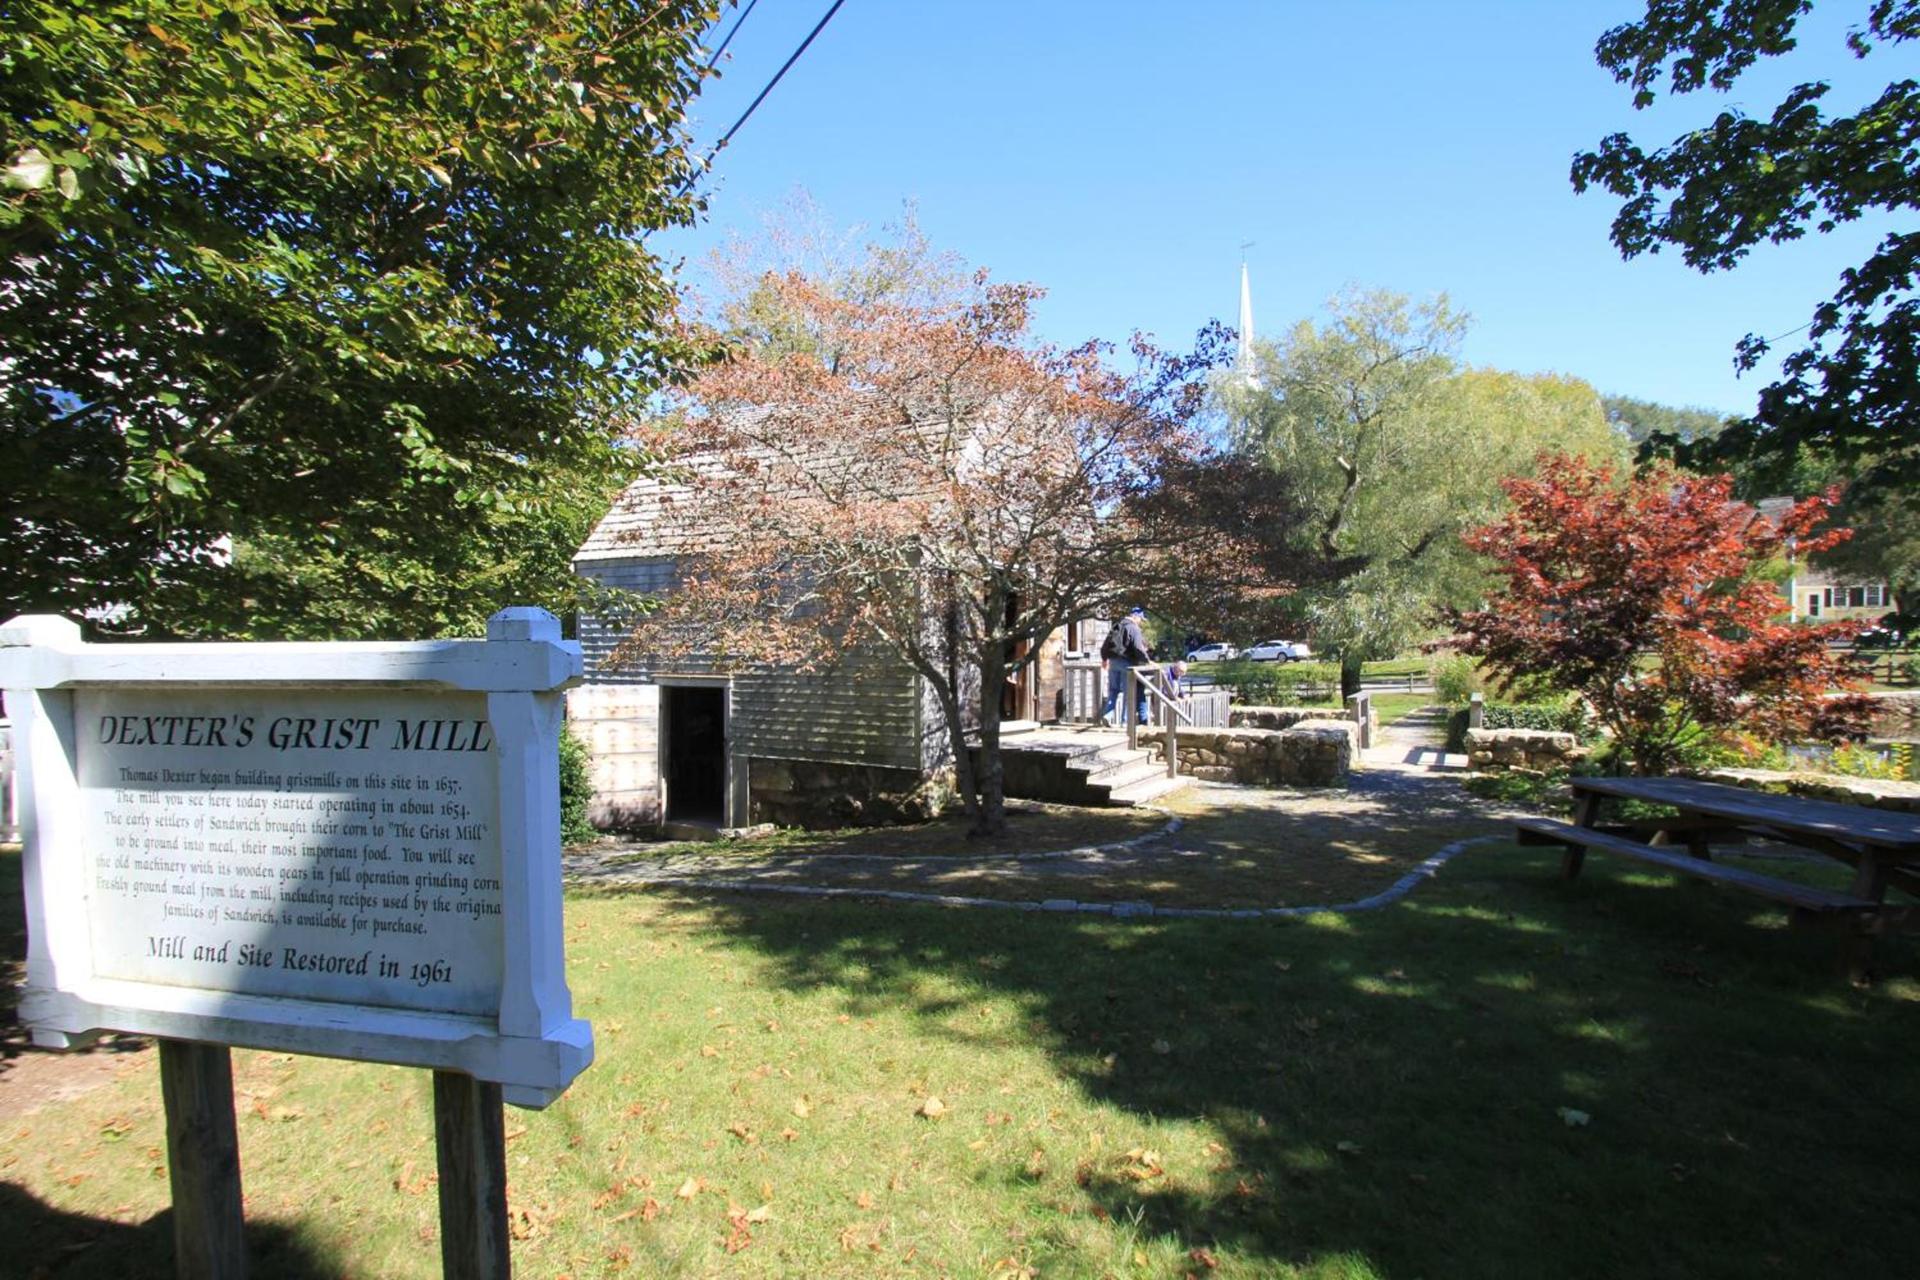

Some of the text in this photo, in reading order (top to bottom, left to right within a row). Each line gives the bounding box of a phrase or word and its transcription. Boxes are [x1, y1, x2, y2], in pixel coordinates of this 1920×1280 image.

[100, 714, 492, 753] DEXTER'S GRIST MILL
[119, 767, 158, 782] Thomas
[162, 768, 196, 784] Dexter
[199, 769, 230, 790] began
[235, 769, 282, 792] building
[287, 771, 341, 792] gristmills
[346, 777, 359, 789] on
[365, 774, 386, 789] this
[390, 776, 411, 790] site
[417, 775, 429, 790] in
[115, 788, 134, 804] The
[139, 789, 161, 805] mill
[165, 794, 183, 811] you
[188, 796, 204, 806] see
[208, 792, 231, 808] here
[236, 795, 268, 815] today
[273, 794, 313, 810] started
[319, 797, 376, 820] operating
[382, 798, 394, 813] in
[400, 798, 434, 815] about
[104, 811, 122, 825] The
[126, 814, 150, 832] early
[154, 813, 190, 828] settlers
[194, 814, 204, 832] of
[209, 815, 260, 832] Sandwich
[265, 818, 306, 840] brought
[312, 819, 338, 834] their
[343, 823, 367, 837] corn
[372, 823, 384, 836] to
[420, 823, 450, 840] Grist
[116, 835, 125, 848] to
[129, 834, 139, 848] be
[144, 835, 179, 855] ground
[183, 837, 204, 851] into
[242, 840, 267, 855] their
[272, 844, 297, 857] most
[302, 842, 357, 865] important
[361, 843, 392, 867] food.
[400, 847, 423, 863] You
[428, 847, 452, 865] will
[457, 852, 475, 865] see
[114, 853, 129, 869] old
[134, 856, 186, 879] machinery
[189, 860, 213, 876] with
[218, 860, 231, 876] its
[235, 862, 274, 878] wooden
[279, 866, 308, 885] gears
[312, 866, 324, 880] in
[328, 865, 351, 888] full
[355, 869, 409, 890] operation
[415, 872, 468, 896] grinding
[96, 875, 128, 897] Freshly
[133, 877, 167, 898] ground
[172, 882, 196, 896] meal
[200, 881, 226, 900] from
[229, 883, 245, 899] the
[280, 887, 334, 911] including
[340, 891, 378, 913] recipes
[383, 894, 408, 910] used
[413, 894, 428, 917] by
[433, 896, 450, 912] the
[456, 898, 501, 921] origina
[162, 899, 428, 937] families of Sandwich, is available for purchase.
[146, 935, 453, 987] Mill and Site Restored in 1961
